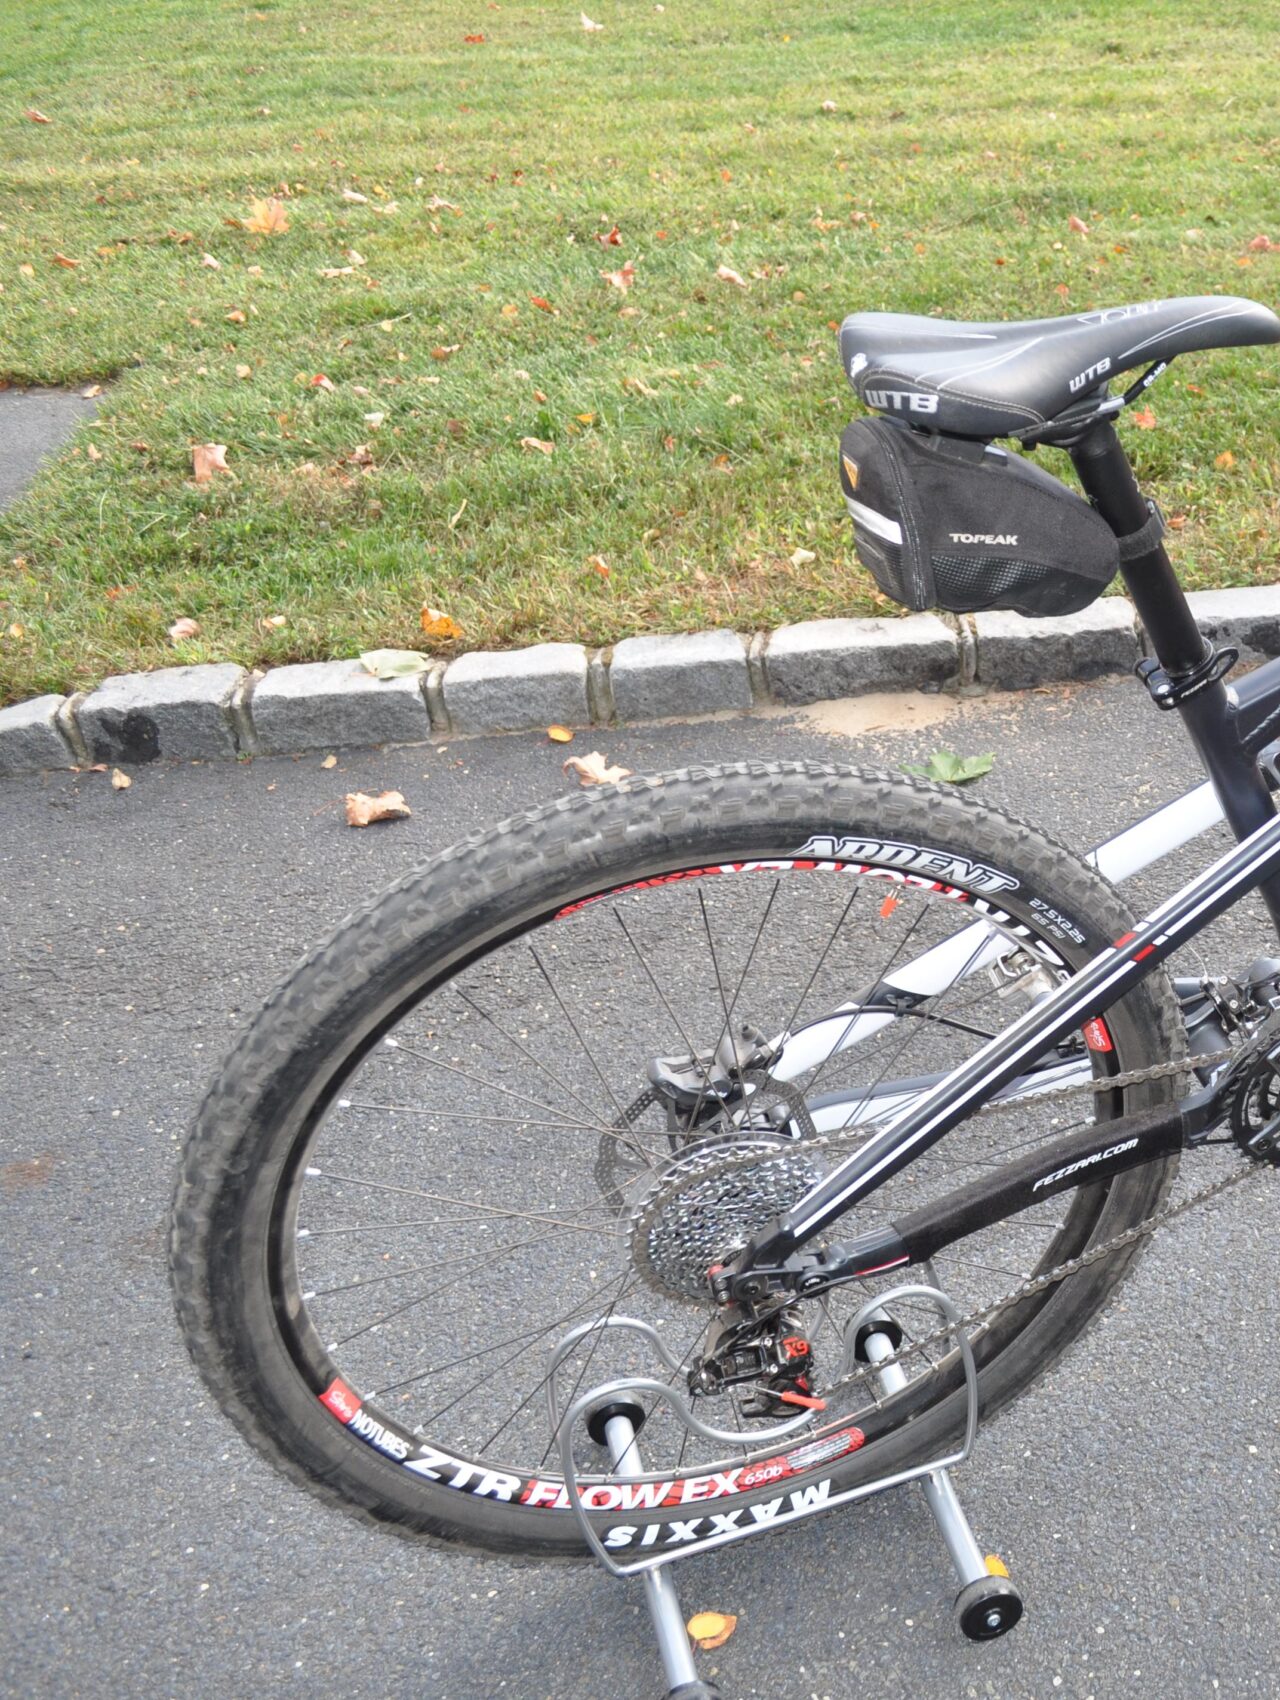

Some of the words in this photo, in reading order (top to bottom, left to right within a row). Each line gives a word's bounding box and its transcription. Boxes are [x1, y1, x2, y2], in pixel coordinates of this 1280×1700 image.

[1069, 357, 1111, 393] WTB
[864, 389, 940, 414] WTB
[949, 533, 1018, 546] TOPEAK
[798, 835, 1020, 894] ARDENT
[1031, 912, 1049, 928] 65
[1049, 923, 1067, 939] PSI
[1032, 1138, 1139, 1192] FEZZARI.COM
[783, 1336, 810, 1359] X9
[350, 1408, 409, 1461] NOTUBES
[403, 1444, 522, 1502] ZTR
[522, 1479, 676, 1511] FLOW
[680, 1467, 744, 1504] EX
[744, 1464, 783, 1486] 650b
[604, 1478, 832, 1548] MAXXIS
